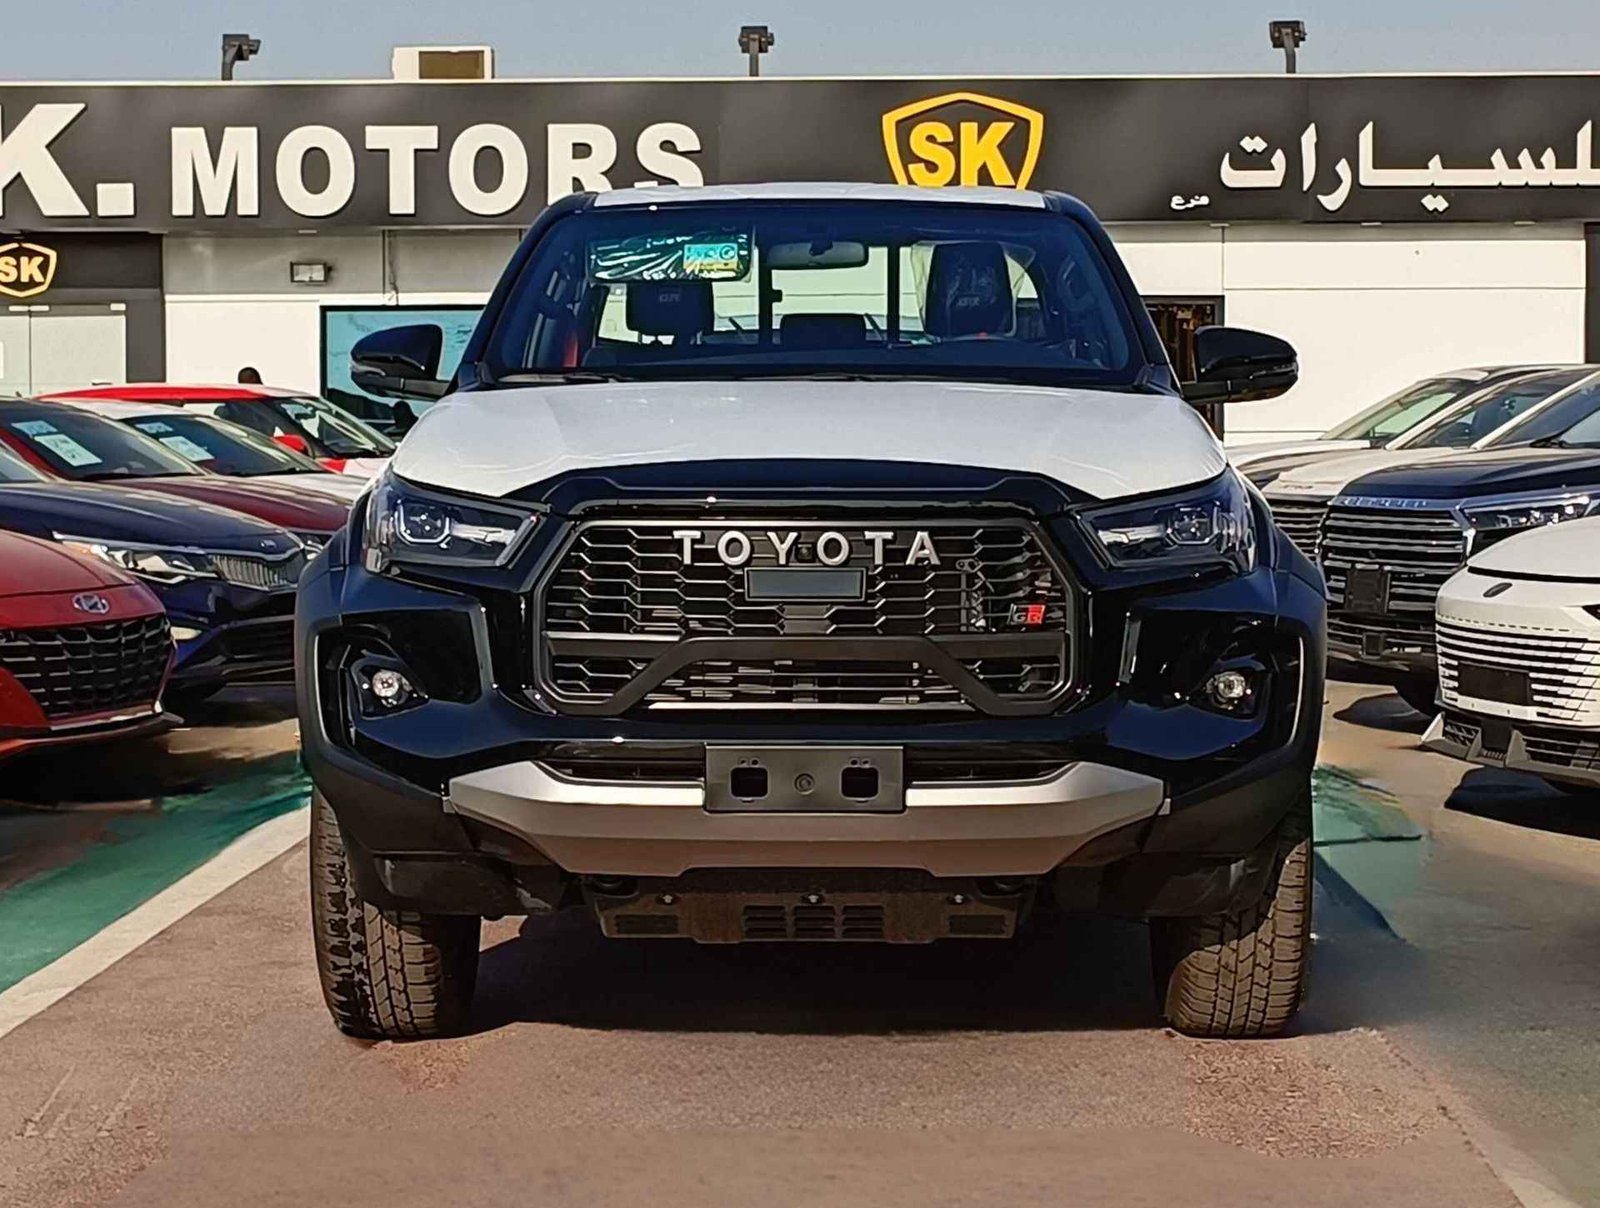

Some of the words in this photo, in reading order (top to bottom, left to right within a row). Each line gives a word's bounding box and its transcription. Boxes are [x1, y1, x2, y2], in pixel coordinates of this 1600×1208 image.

[170, 122, 704, 217] MOTORS
[907, 121, 1016, 188] SK
[1170, 195, 1210, 210] فرع
[0, 256, 45, 283] SK
[672, 529, 941, 567] TOYOTA
